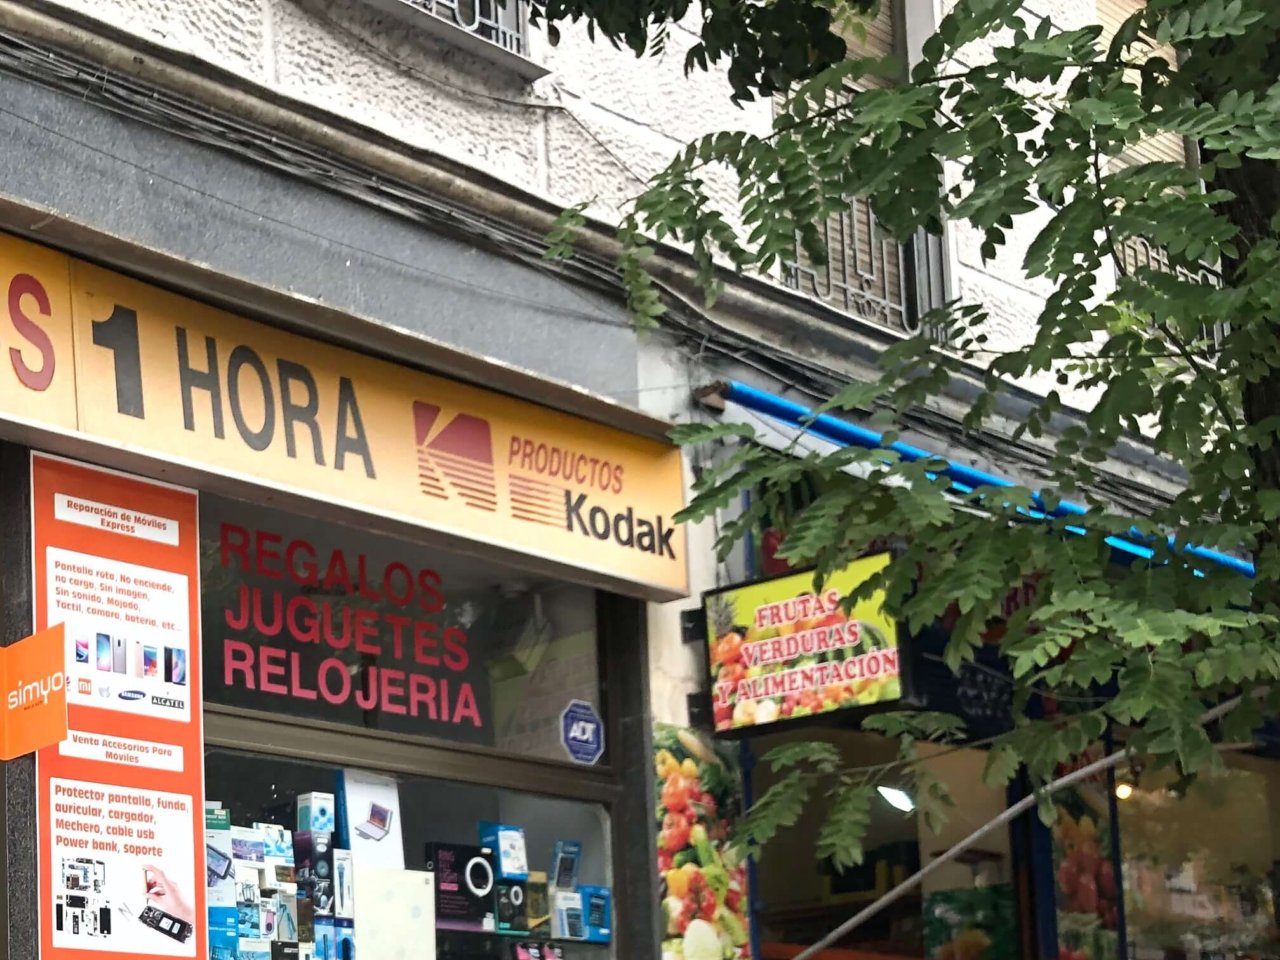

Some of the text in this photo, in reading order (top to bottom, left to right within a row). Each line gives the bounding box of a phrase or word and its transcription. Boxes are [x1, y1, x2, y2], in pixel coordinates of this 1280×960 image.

[92, 304, 145, 420] 1
[176, 326, 376, 479] HORA
[508, 435, 624, 494] PRODUCTOS
[67, 500, 167, 530] Reparación de Móviles
[100, 517, 135, 533] Express
[564, 490, 677, 560] Kodak
[55, 560, 93, 577] Pantalla
[120, 574, 132, 585] No
[134, 577, 174, 593] enciende,
[55, 575, 67, 584] no
[100, 582, 113, 593] Sin
[221, 522, 445, 614] REGALOS
[55, 587, 70, 597] Sin
[756, 591, 839, 628] FRUTAS
[225, 584, 469, 671] JUGUETES
[741, 622, 861, 667] VERDURAS
[8, 672, 65, 711] simyo
[223, 639, 482, 727] RELOJERIA
[717, 648, 899, 706] Y ALIMENTACIÓN
[152, 697, 185, 709] ALCATEL
[72, 734, 172, 757] Venta Accesorios Para
[55, 784, 188, 813] Protector pantalla, funda,
[55, 802, 157, 826] auricular, cargador,
[55, 818, 154, 840] Mechero, cable usb
[56, 835, 163, 857] Power bank, soporte
